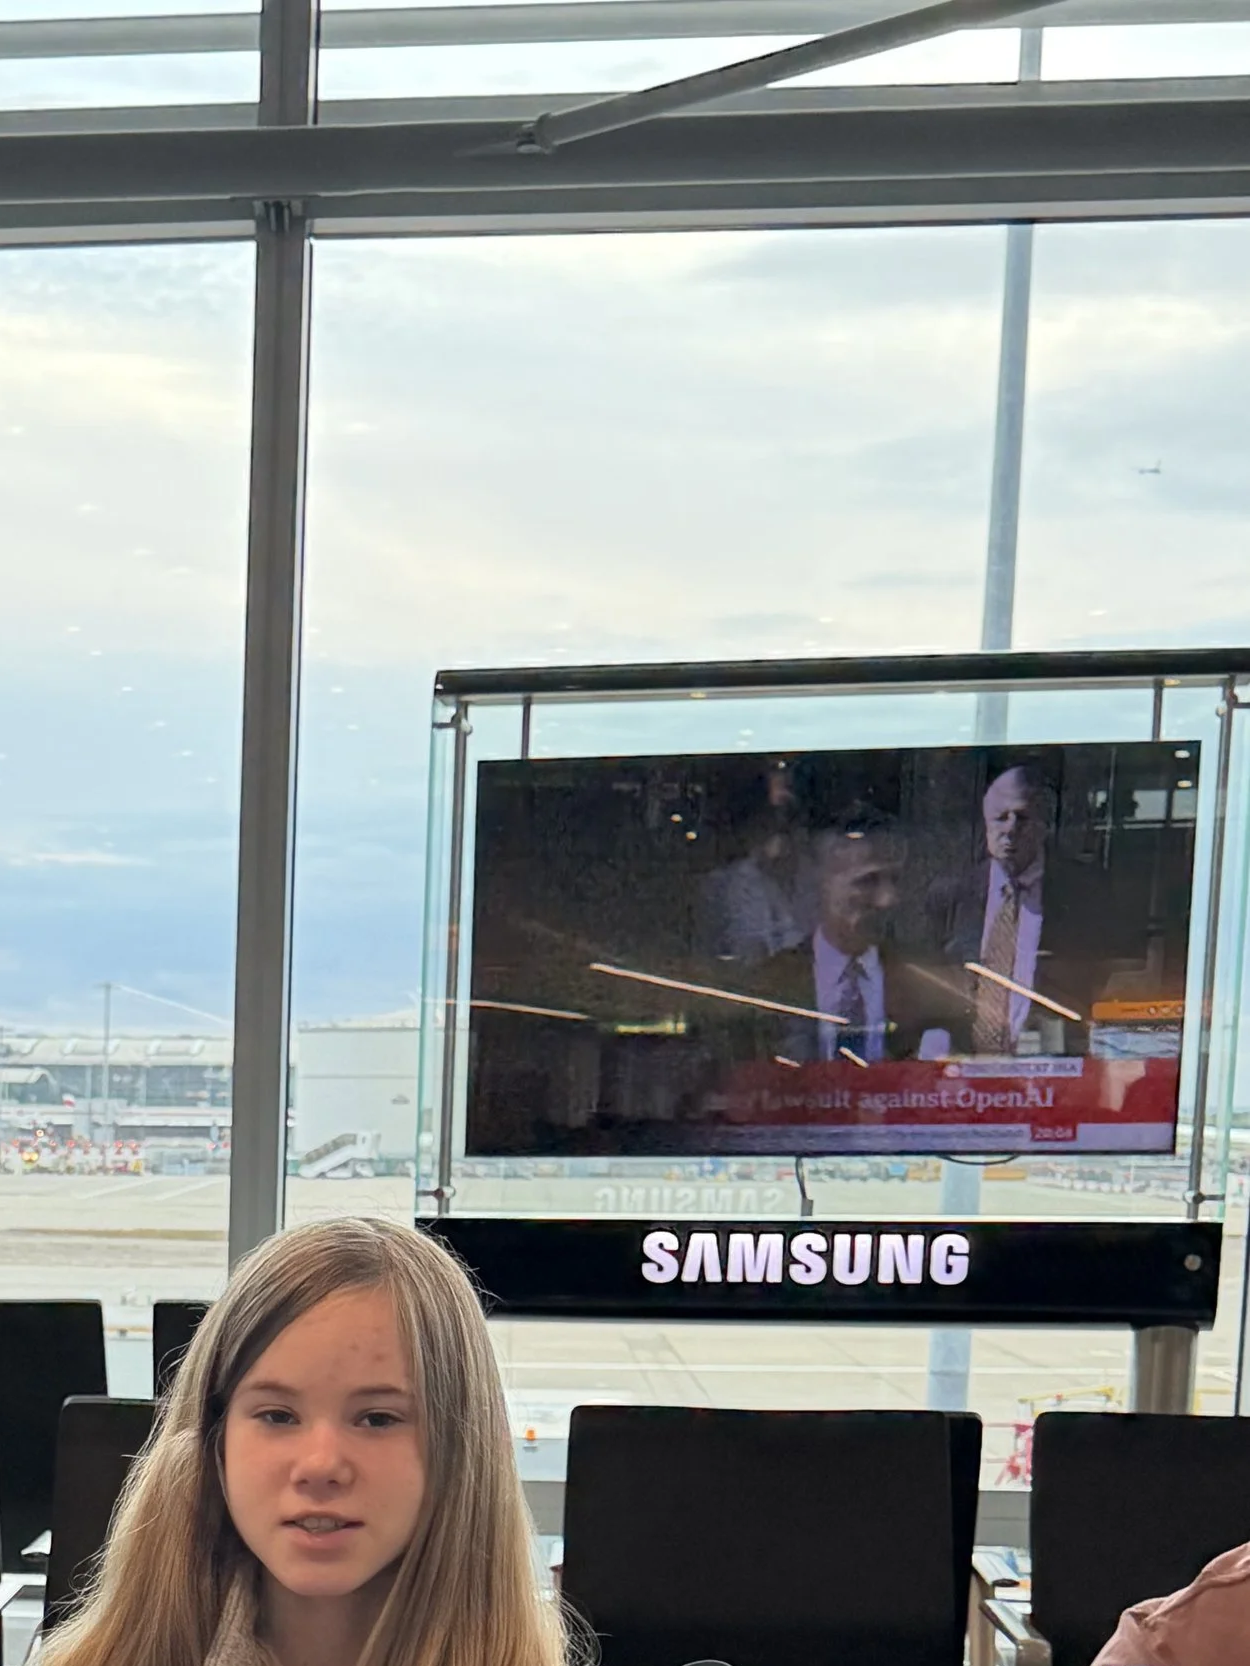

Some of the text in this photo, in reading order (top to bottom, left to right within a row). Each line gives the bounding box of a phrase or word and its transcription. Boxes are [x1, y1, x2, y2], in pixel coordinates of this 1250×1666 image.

[858, 1088, 950, 1115] against
[955, 1086, 1055, 1113] OpenAI
[641, 1231, 971, 1286] SAMSUNG
